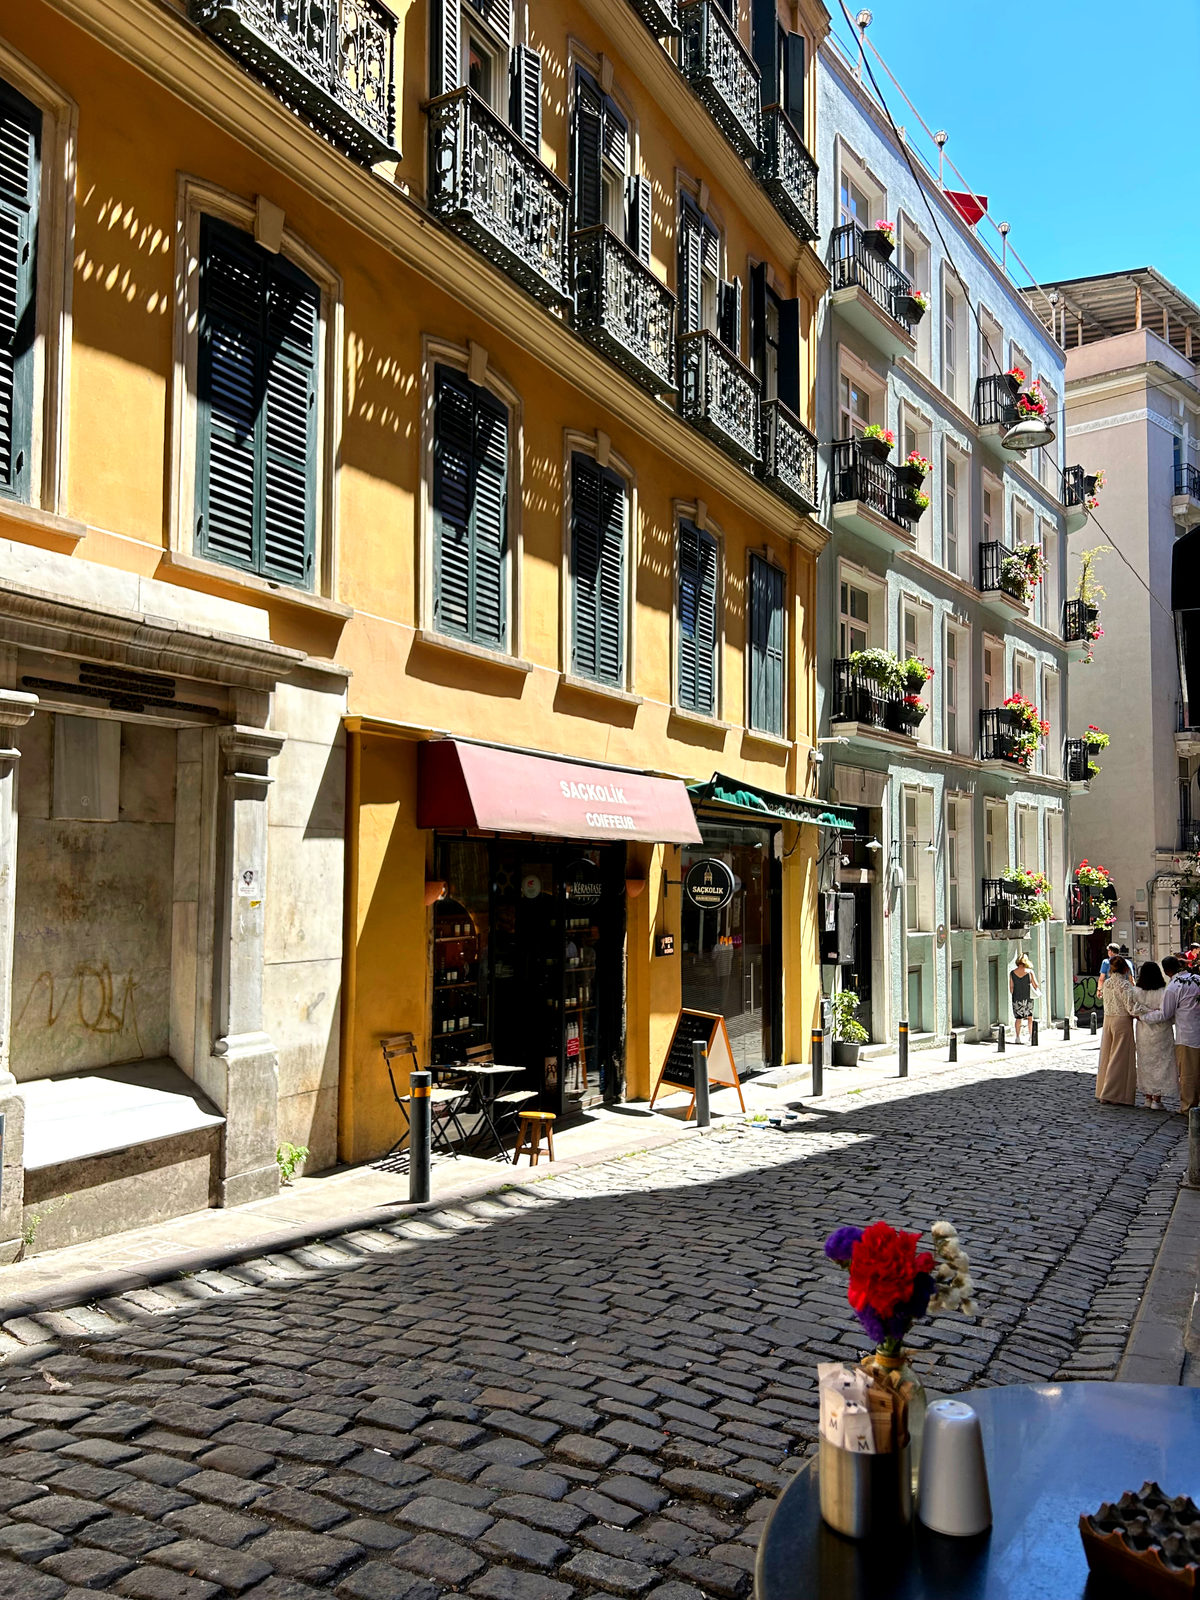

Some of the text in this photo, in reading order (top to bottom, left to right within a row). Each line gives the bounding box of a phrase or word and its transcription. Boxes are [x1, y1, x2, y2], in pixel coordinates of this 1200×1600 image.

[560, 780, 627, 804] SAÇKOLİK
[585, 812, 636, 830] COIFFEUR
[829, 1417, 838, 1430] M
[857, 1440, 870, 1451] M
